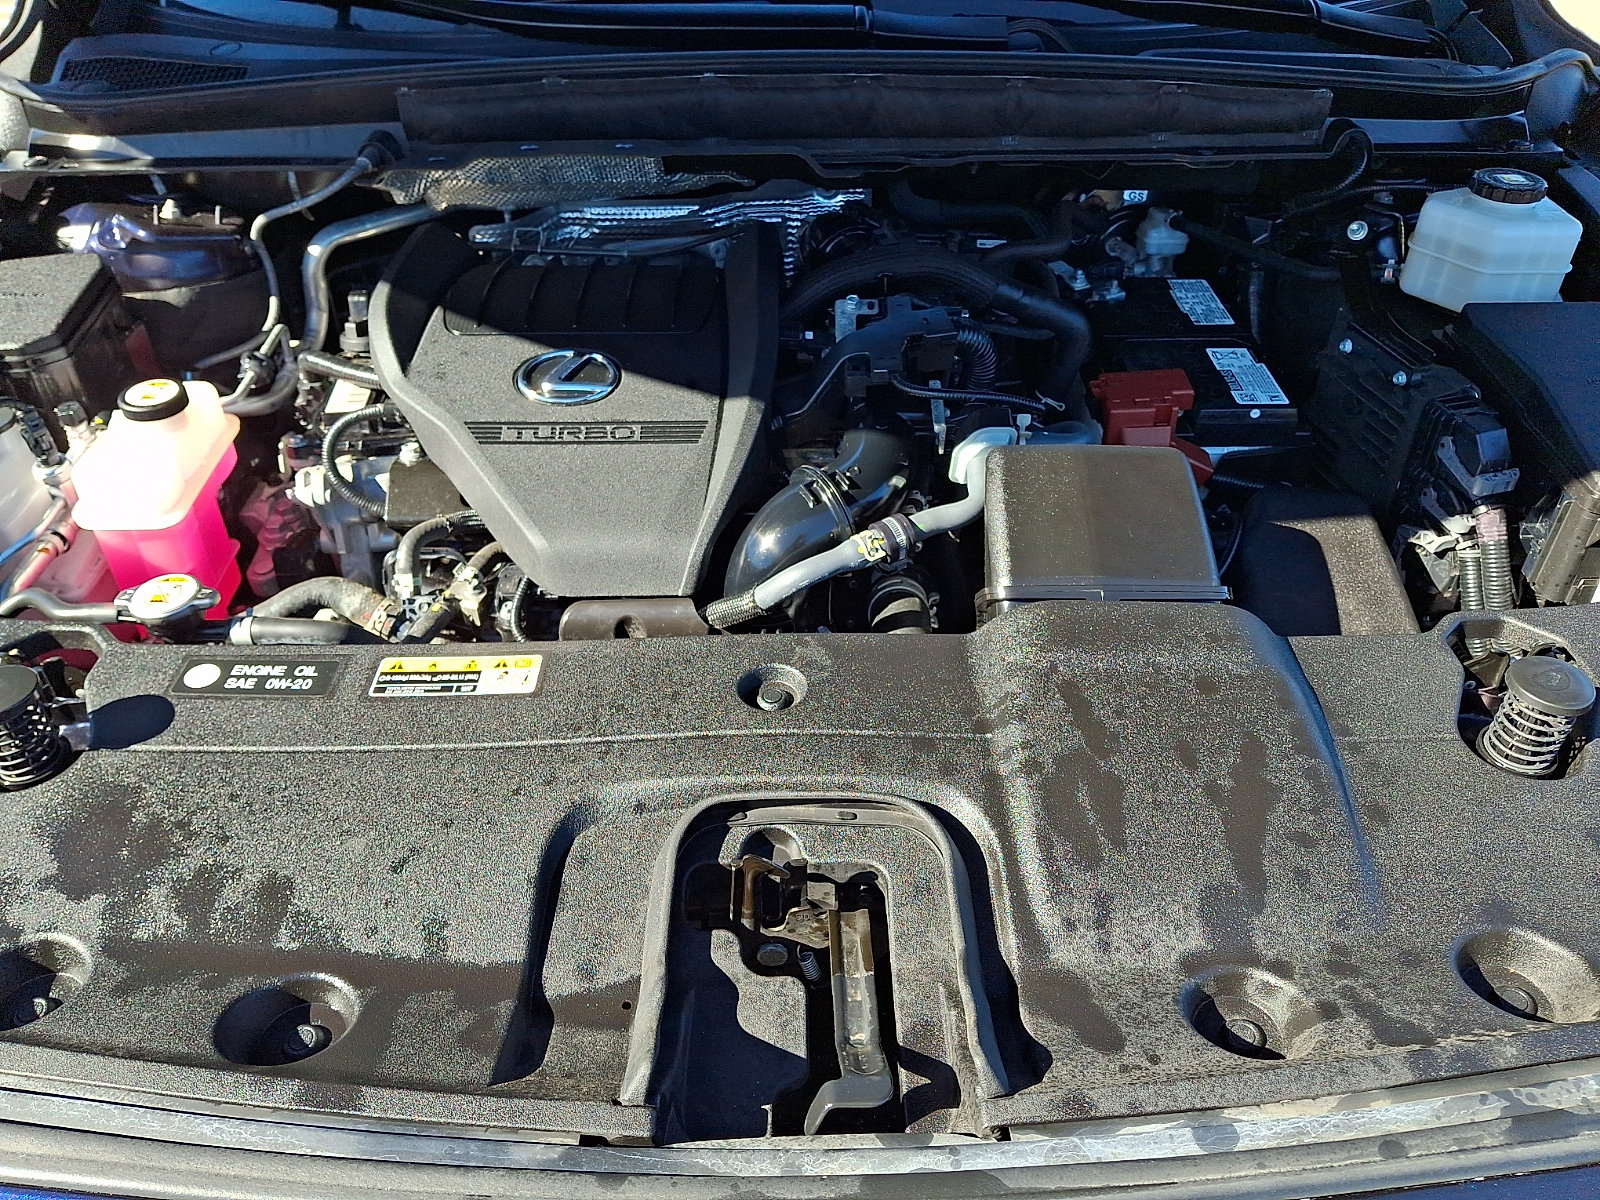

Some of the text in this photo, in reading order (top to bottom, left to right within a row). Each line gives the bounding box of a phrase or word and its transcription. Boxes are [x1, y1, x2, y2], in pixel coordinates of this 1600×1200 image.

[1128, 191, 1144, 202] GS
[506, 426, 636, 440] TURBO
[230, 664, 319, 677] ENGINE OIL
[223, 678, 314, 690] SAE 0W-20
